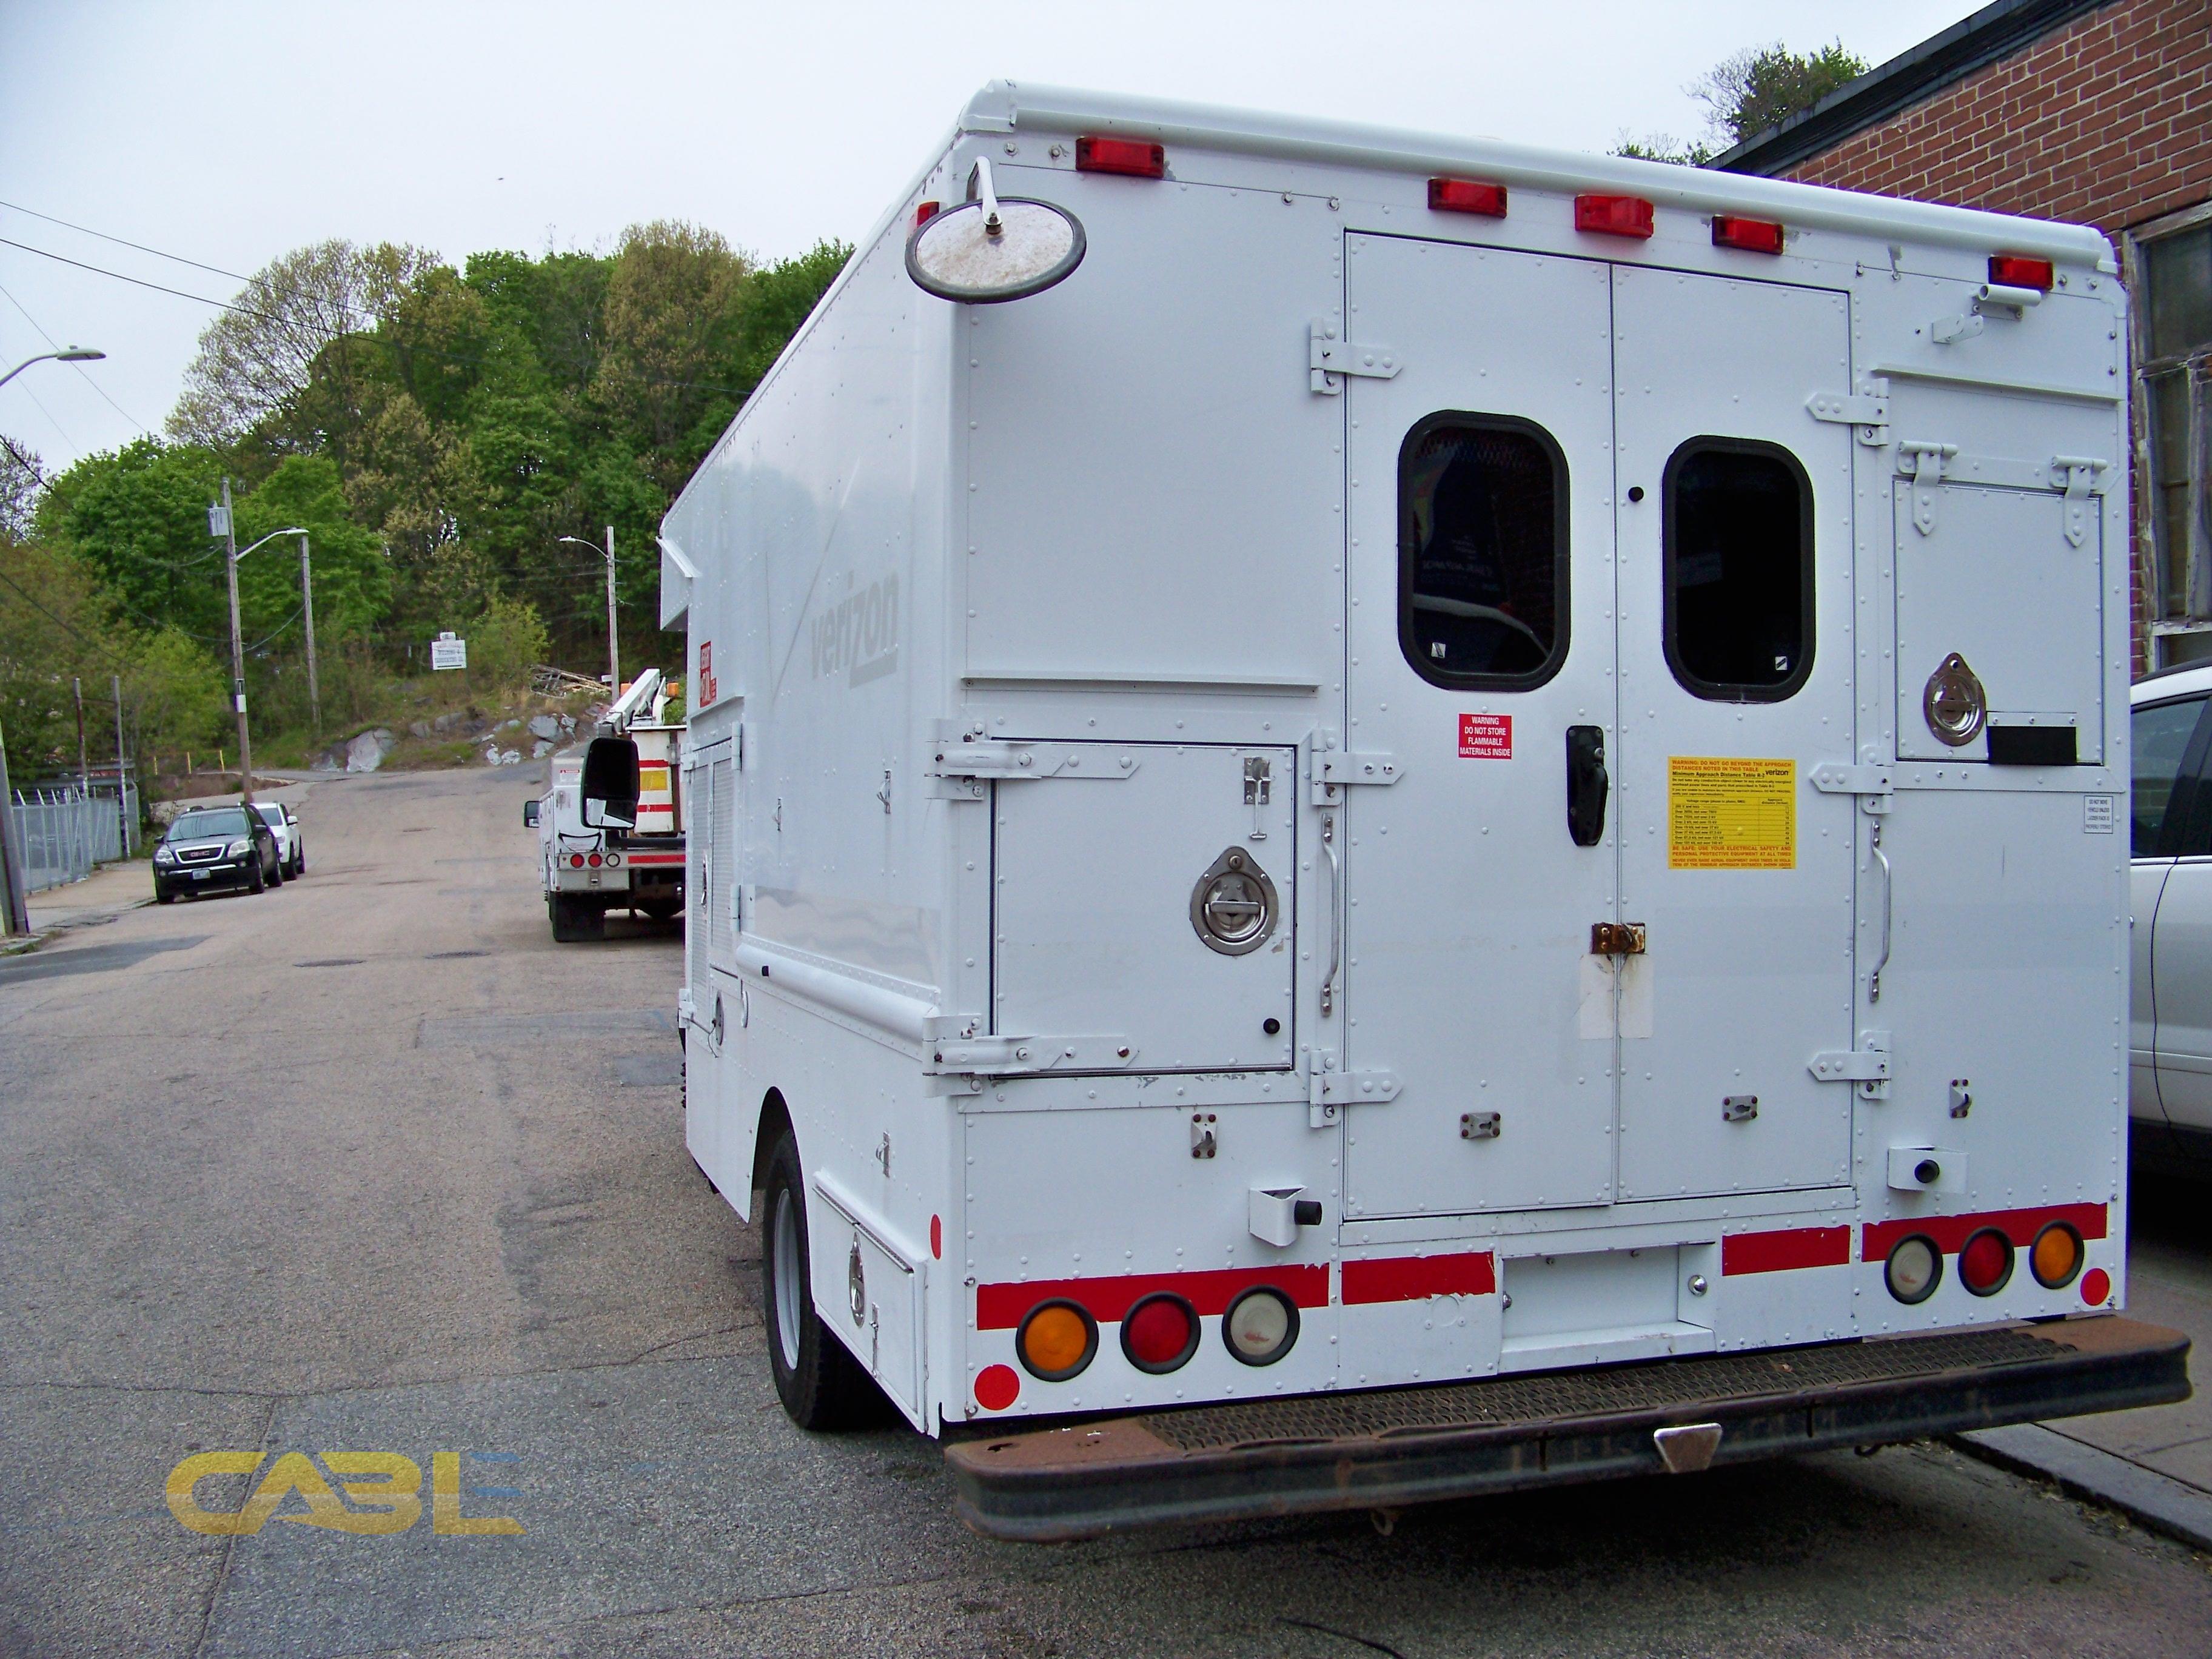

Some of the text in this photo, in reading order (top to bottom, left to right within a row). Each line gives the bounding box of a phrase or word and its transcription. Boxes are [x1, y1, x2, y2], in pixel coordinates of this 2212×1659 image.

[1472, 716, 1499, 725] WARNING
[1487, 727, 1506, 736] STORE
[1468, 737, 1503, 746] FLAMMABLE
[1460, 747, 1491, 756] MATERIALS
